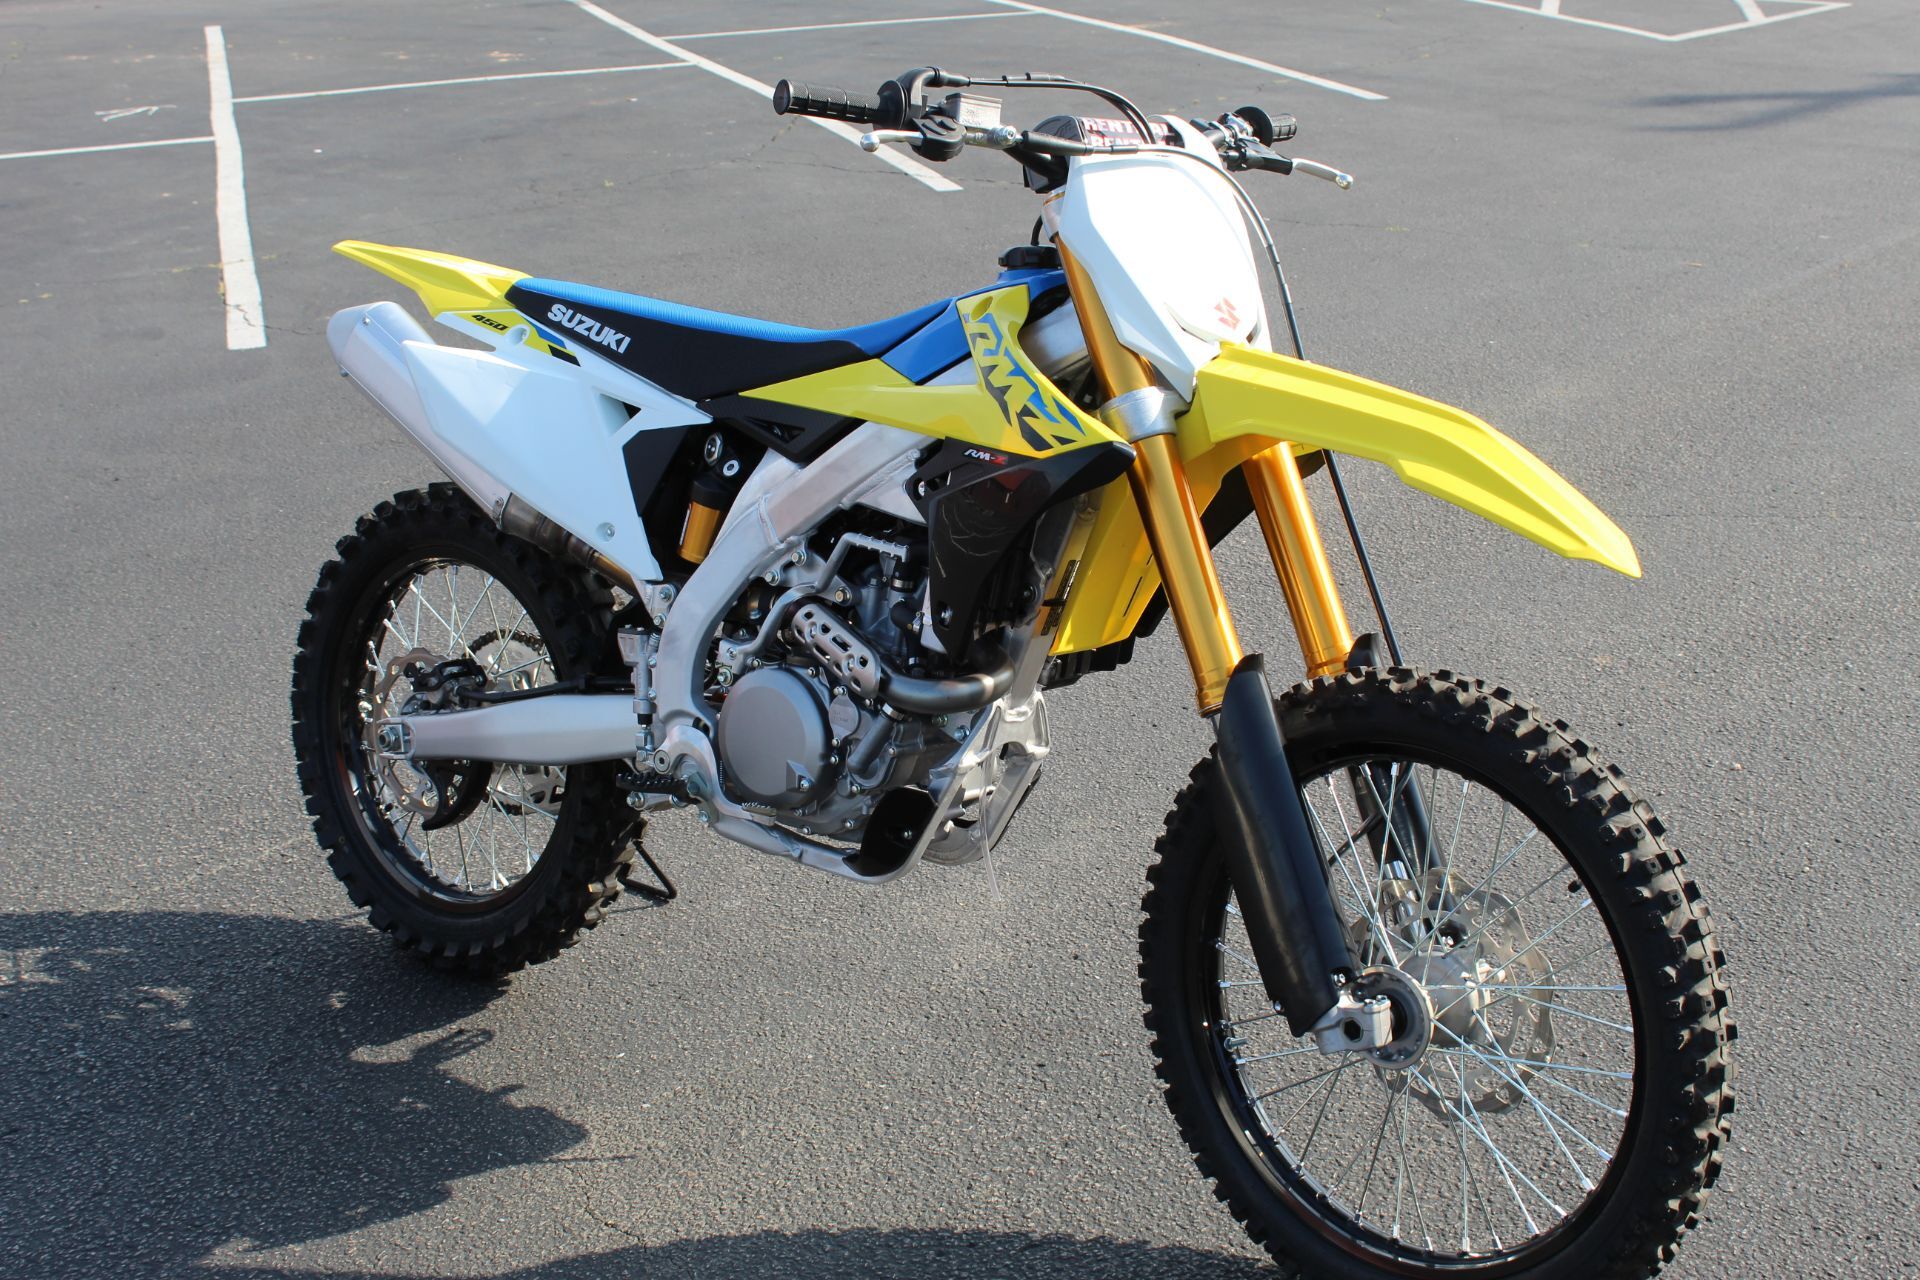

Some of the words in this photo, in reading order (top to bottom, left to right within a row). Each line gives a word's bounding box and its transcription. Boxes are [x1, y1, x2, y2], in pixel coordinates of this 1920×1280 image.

[1083, 117, 1174, 137] RENTAL
[471, 314, 509, 331] 450
[547, 303, 631, 354] SUZUKI
[963, 448, 1008, 465] RM-Z
